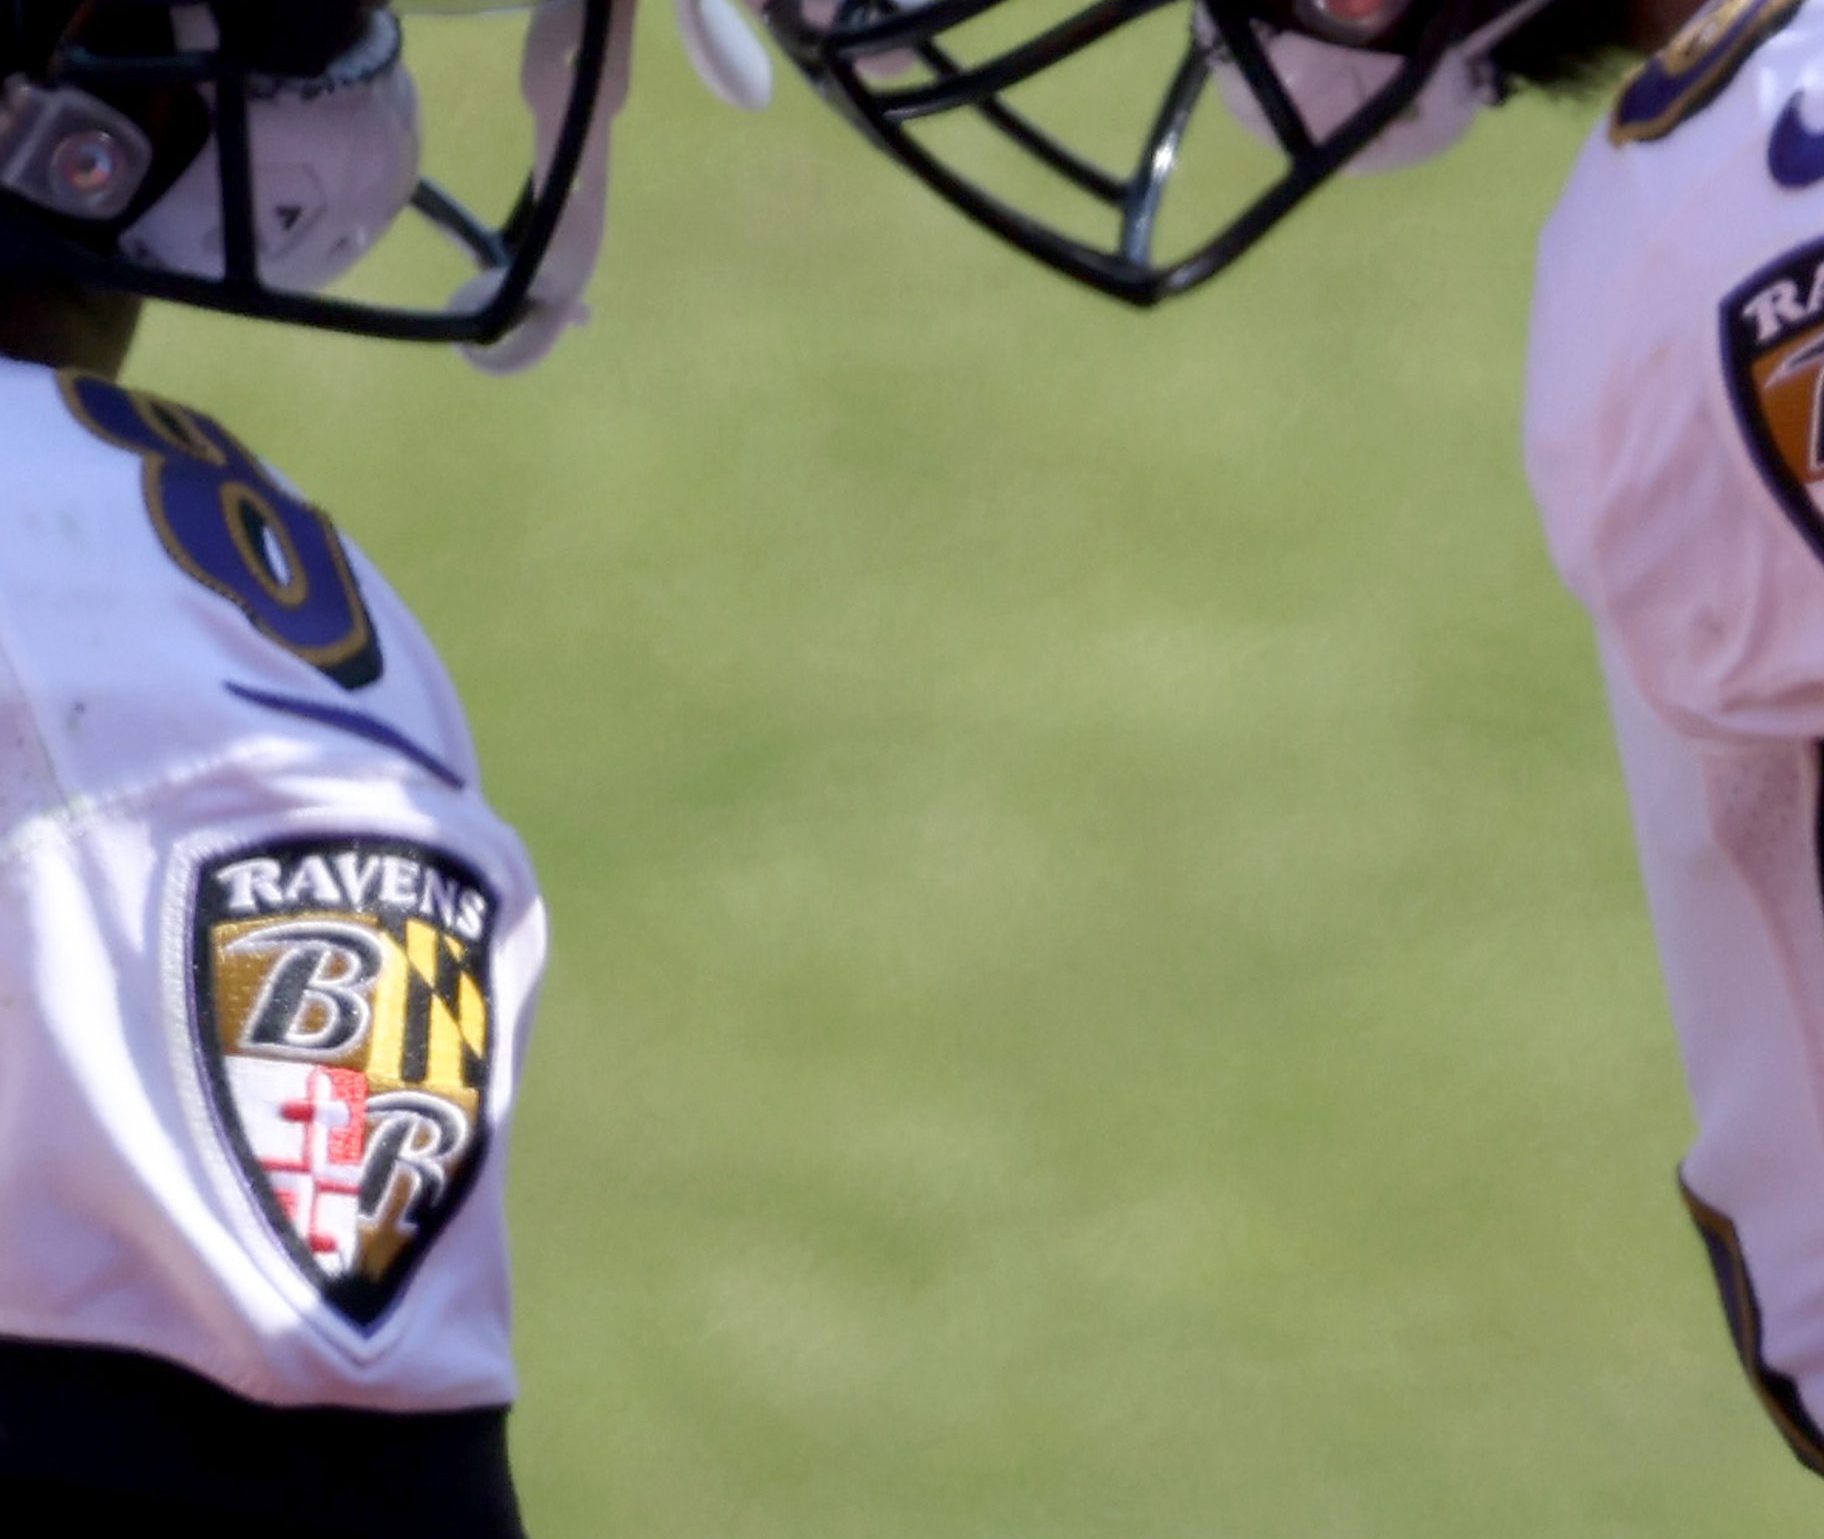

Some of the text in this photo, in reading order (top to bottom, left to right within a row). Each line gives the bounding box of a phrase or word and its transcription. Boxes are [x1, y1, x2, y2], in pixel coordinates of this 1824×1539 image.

[58, 368, 385, 692] 8
[216, 850, 487, 940] RAVENS
[221, 919, 383, 1058] B
[357, 1090, 473, 1235] R
